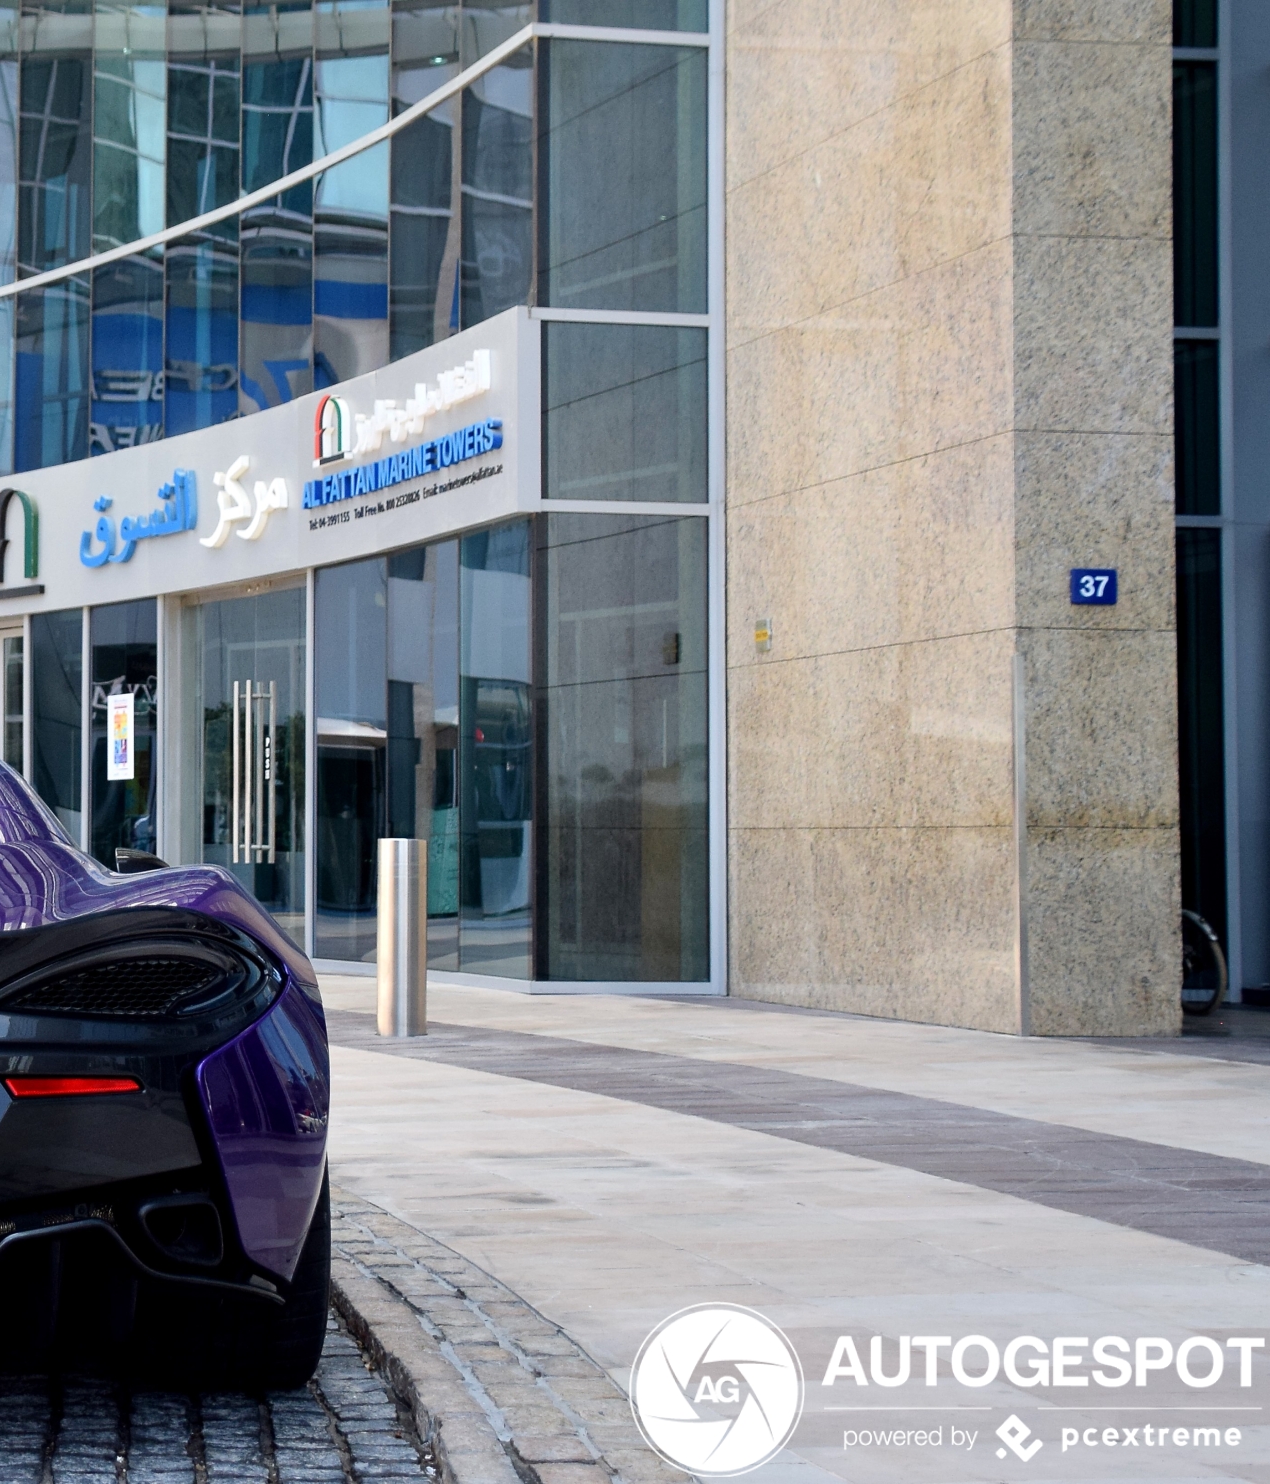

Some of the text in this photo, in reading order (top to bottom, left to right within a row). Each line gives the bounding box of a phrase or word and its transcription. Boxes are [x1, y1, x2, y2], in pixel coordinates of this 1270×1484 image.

[303, 416, 504, 510] AL FATTAN MARINE TOWERS
[80, 455, 288, 568] مركز التسوق
[354, 506, 364, 519] Toll
[365, 504, 377, 517] Free
[1080, 575, 1109, 597] 37
